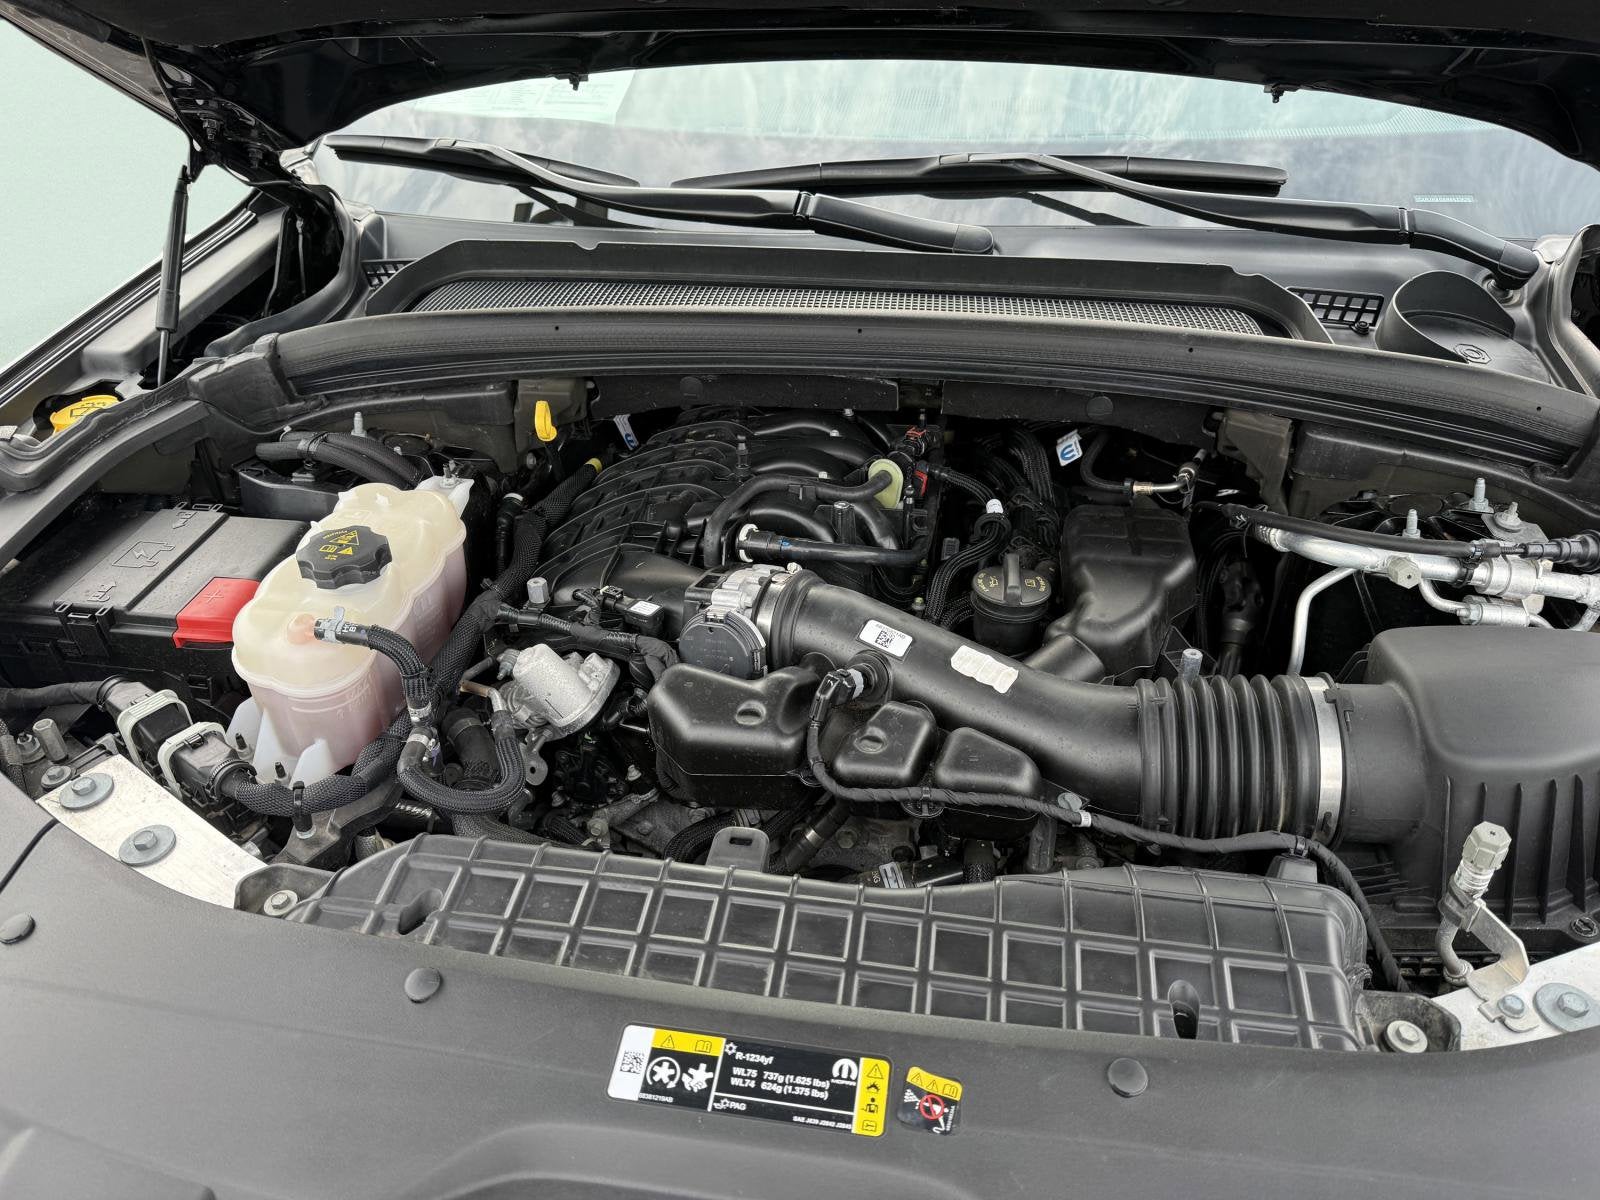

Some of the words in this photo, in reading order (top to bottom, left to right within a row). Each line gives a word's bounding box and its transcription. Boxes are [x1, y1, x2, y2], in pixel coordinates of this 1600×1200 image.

[734, 1051, 774, 1065] R-1234yf
[732, 1067, 758, 1078] WL75
[763, 1071, 784, 1084] 737g
[785, 1074, 812, 1086] (1.625
[813, 1077, 830, 1090] lbs)
[730, 1077, 756, 1088] WL74
[760, 1082, 782, 1094] 624g
[783, 1085, 810, 1097] (1.375
[811, 1089, 829, 1100] lbs)
[729, 1102, 747, 1111] PAG
